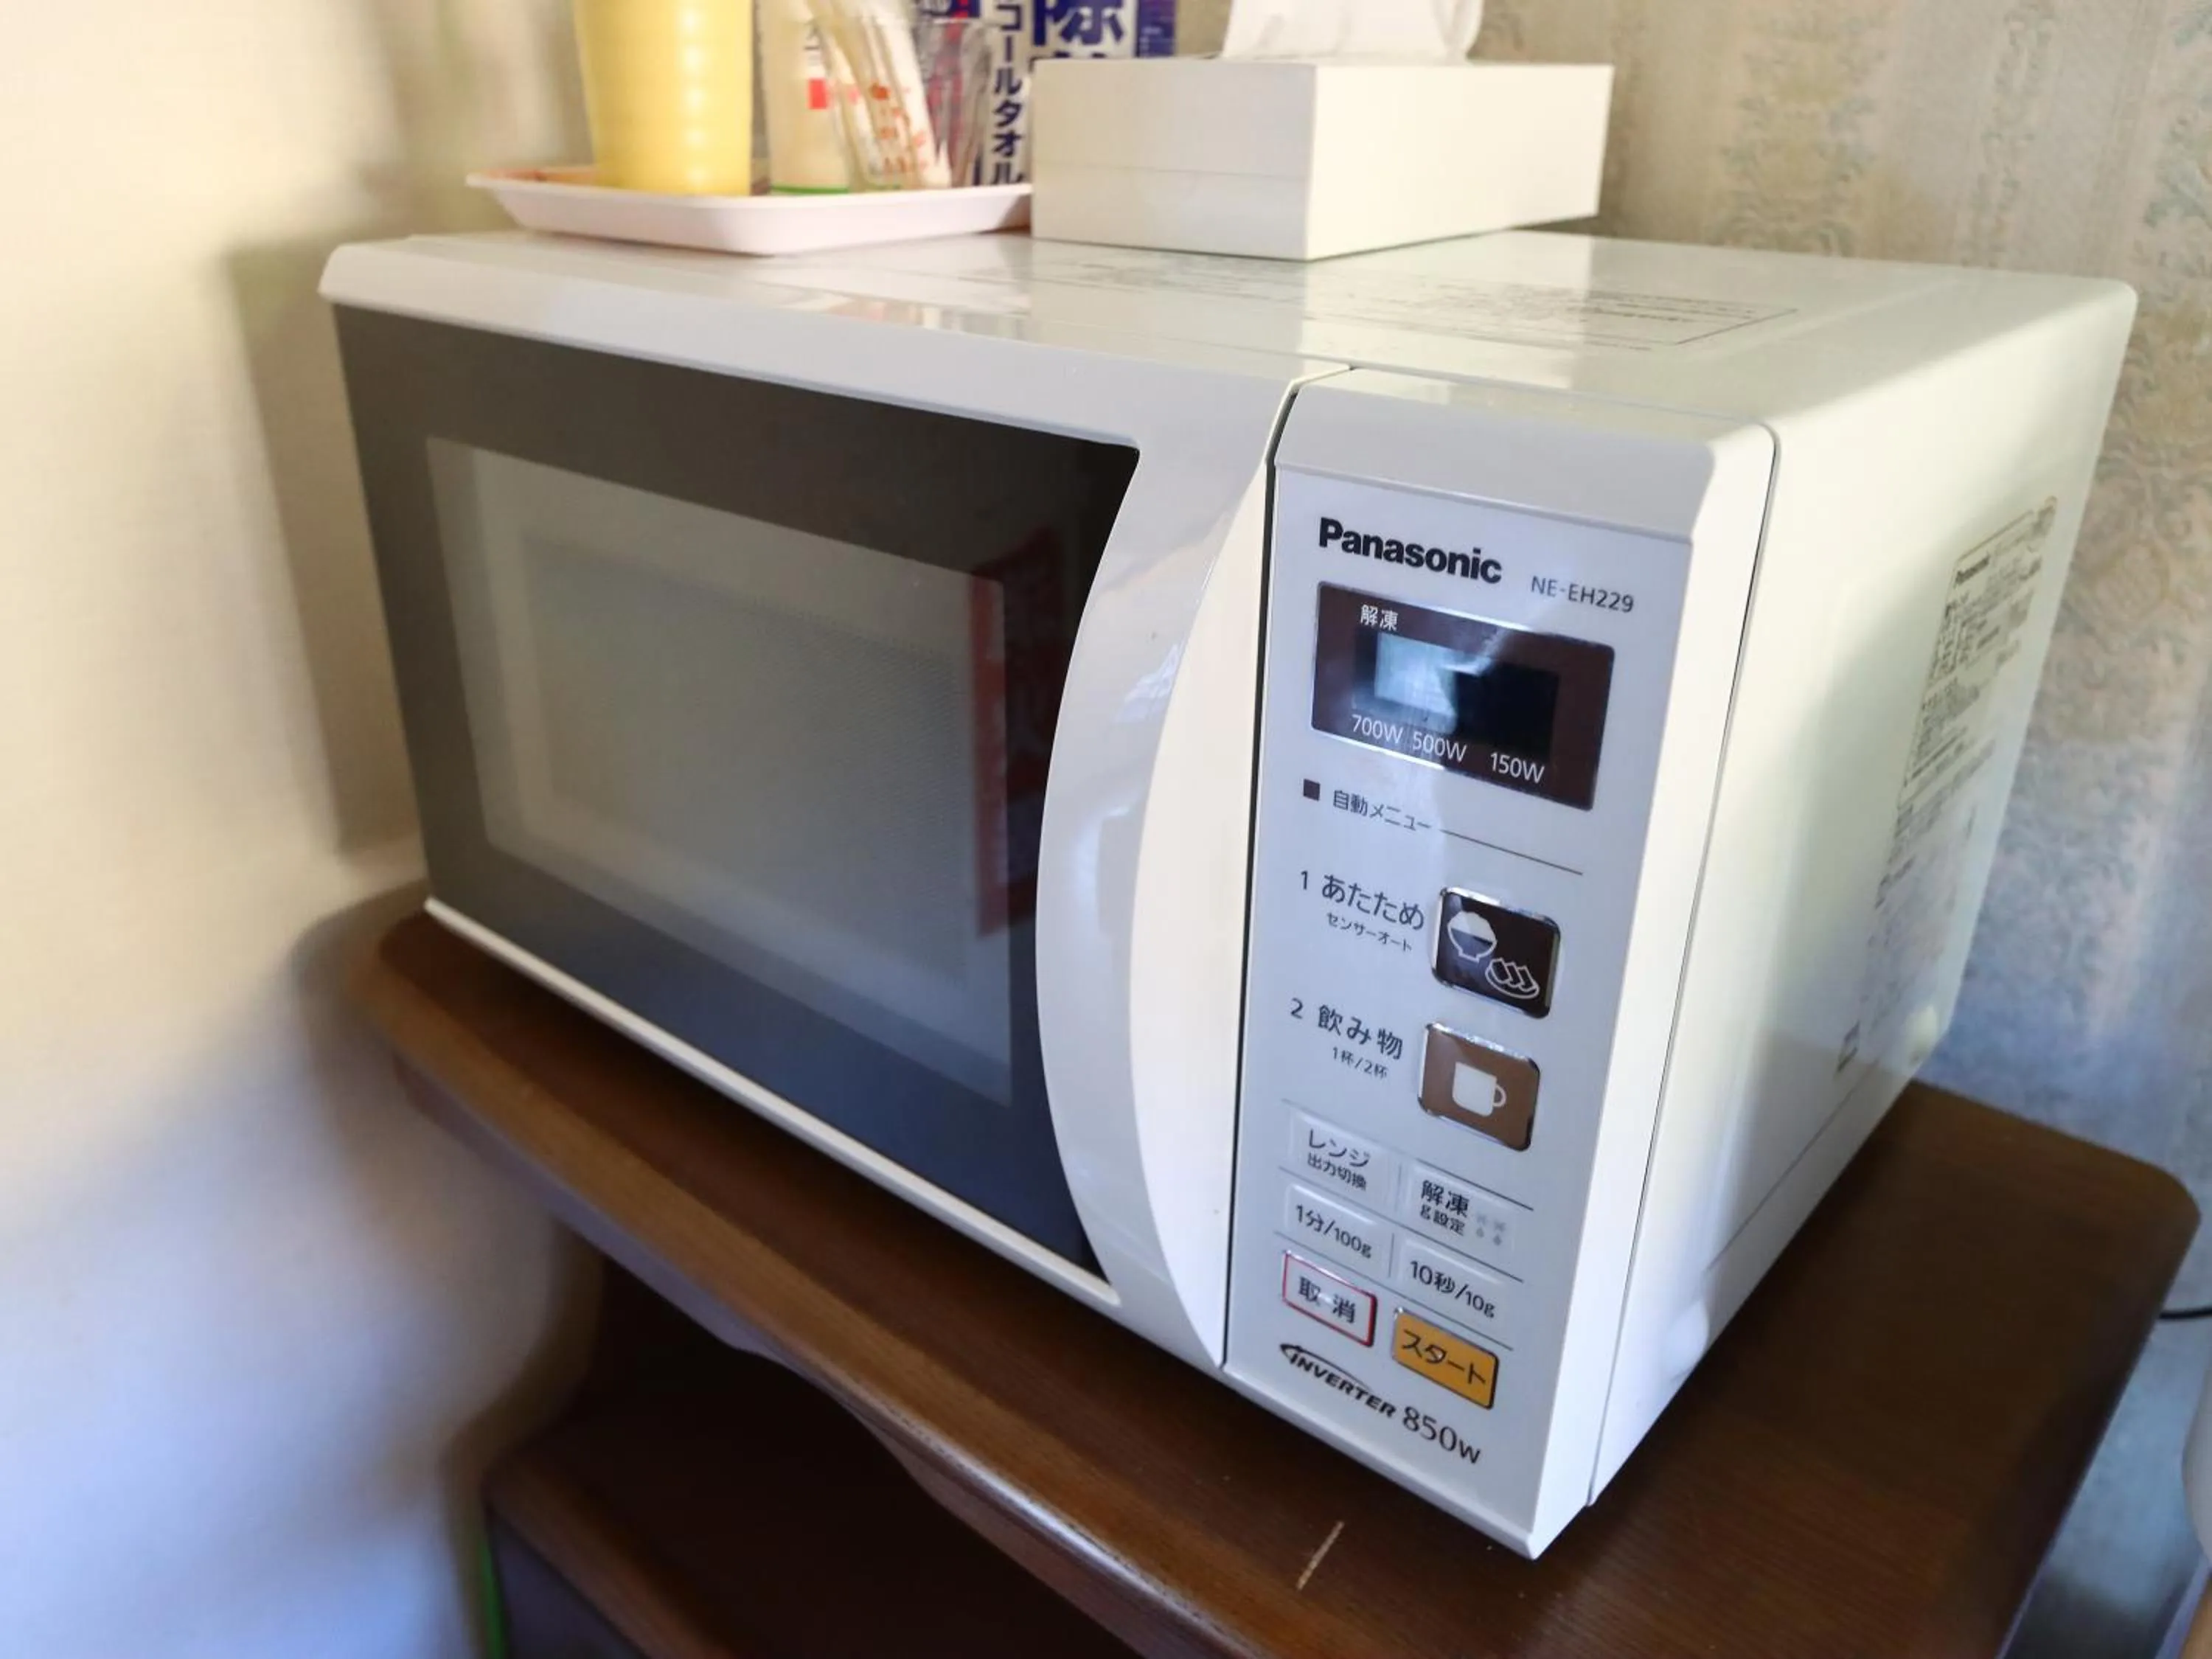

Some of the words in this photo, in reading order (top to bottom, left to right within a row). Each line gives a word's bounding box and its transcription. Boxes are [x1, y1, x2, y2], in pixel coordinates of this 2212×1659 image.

[1318, 516, 1503, 584] Panasonic
[1360, 603, 1399, 632] 解凍
[1530, 575, 1635, 613] NE-EH229
[1351, 714, 1404, 744] 700W
[1412, 731, 1468, 763] 500W
[1489, 752, 1545, 785] 150W
[1332, 789, 1431, 832] 自動メニュー
[1300, 870, 1309, 891] 1
[1321, 874, 1425, 931] あたため
[1326, 912, 1413, 953] センサーオート
[1290, 998, 1304, 1020] 2
[1317, 1004, 1404, 1060] 飲み物
[1306, 1151, 1368, 1192] 出力切換
[1307, 1127, 1371, 1168] レンジ
[1420, 1178, 1470, 1218] 解凍
[1295, 1203, 1372, 1260] 1分/100g
[1409, 1259, 1496, 1319] 10秒/10g
[1287, 1349, 1397, 1419] INVERTER
[1402, 1328, 1486, 1386] スタート
